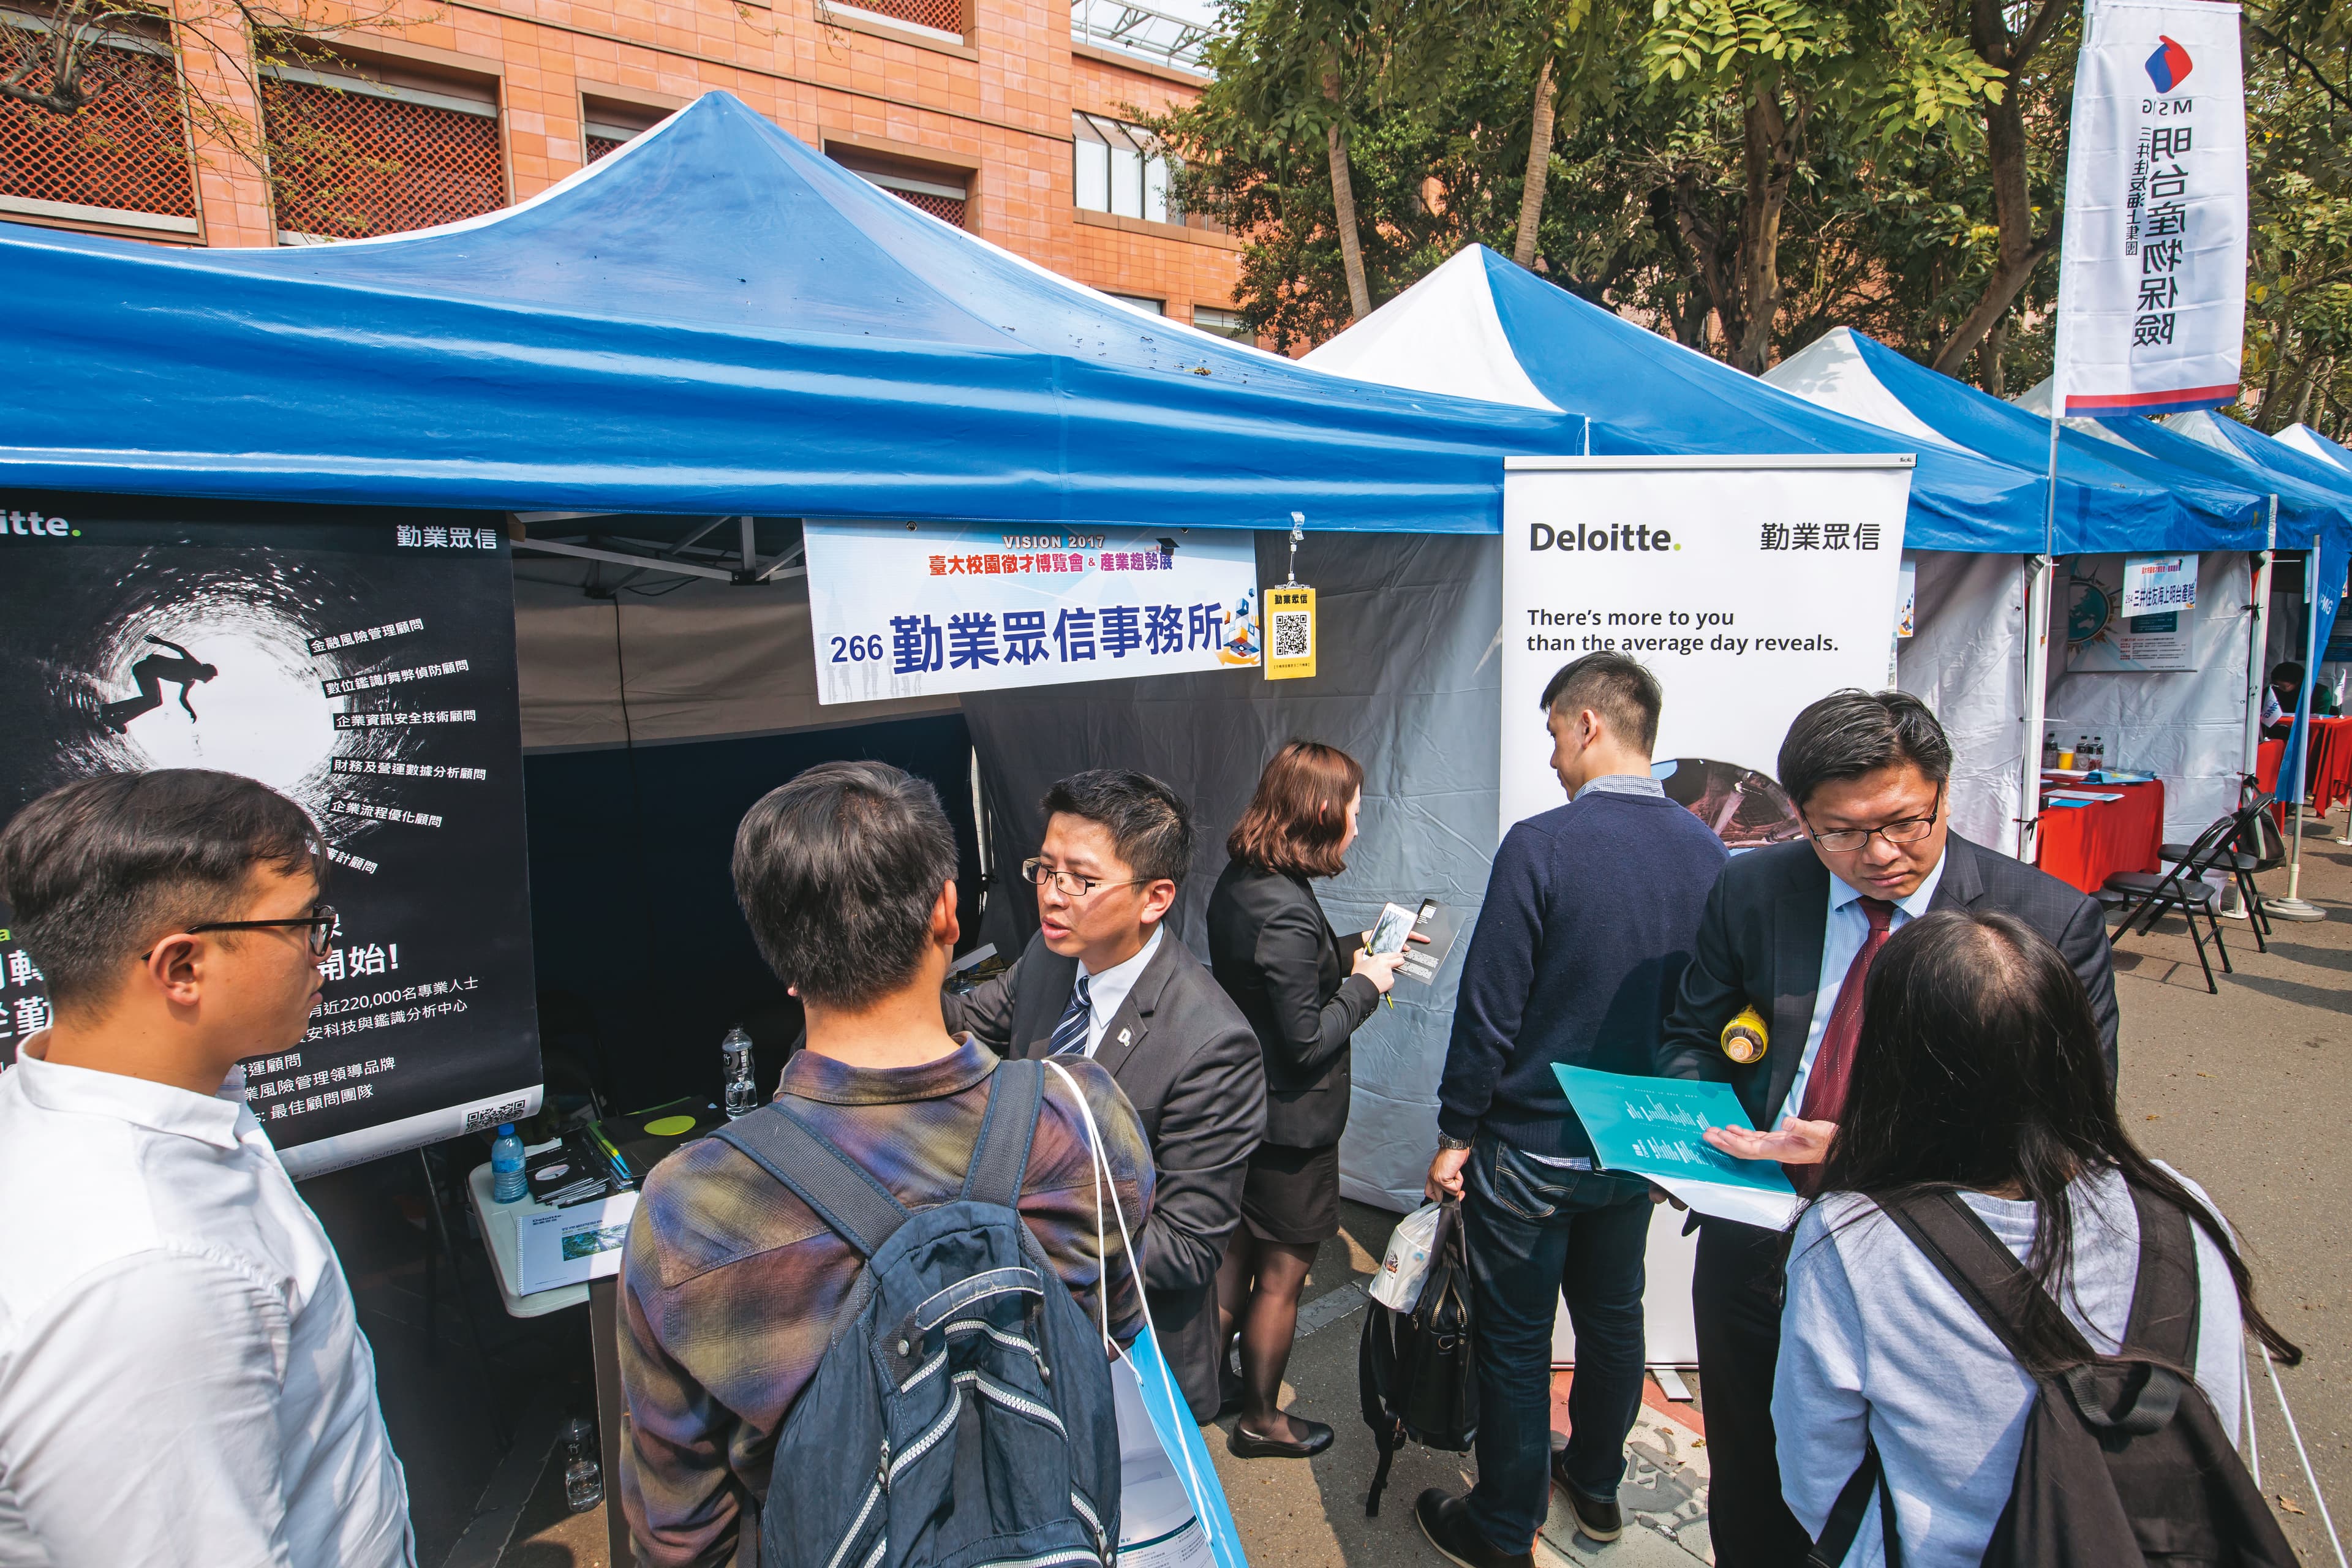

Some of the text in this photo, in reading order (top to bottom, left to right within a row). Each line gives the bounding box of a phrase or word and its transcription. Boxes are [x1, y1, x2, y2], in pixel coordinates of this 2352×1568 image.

[396, 524, 497, 549] 勤業眾信
[1001, 535, 1105, 549] VISION 2017
[1530, 522, 1682, 552] Deloitte.
[1760, 522, 1881, 551] 勤業眾信
[1088, 557, 1096, 567] &
[1275, 594, 1308, 605] 勤業眾信
[1608, 612, 1662, 626] more
[1668, 610, 1690, 626] to
[1696, 612, 1735, 633] you
[311, 618, 424, 654] 金融風險管理顧問
[830, 602, 1224, 675] 266 勤業眾信事務所
[1526, 634, 1839, 656] than the average day reveals.
[336, 710, 477, 728] 企業資訊安全技術顧問
[333, 760, 486, 780] 財務及營運數據分析顧問
[331, 800, 443, 827] 企業流程優化顧問
[300, 998, 468, 1042] 安科技與鑑識分析中心
[271, 1084, 374, 1120] 最佳顧問團隊
